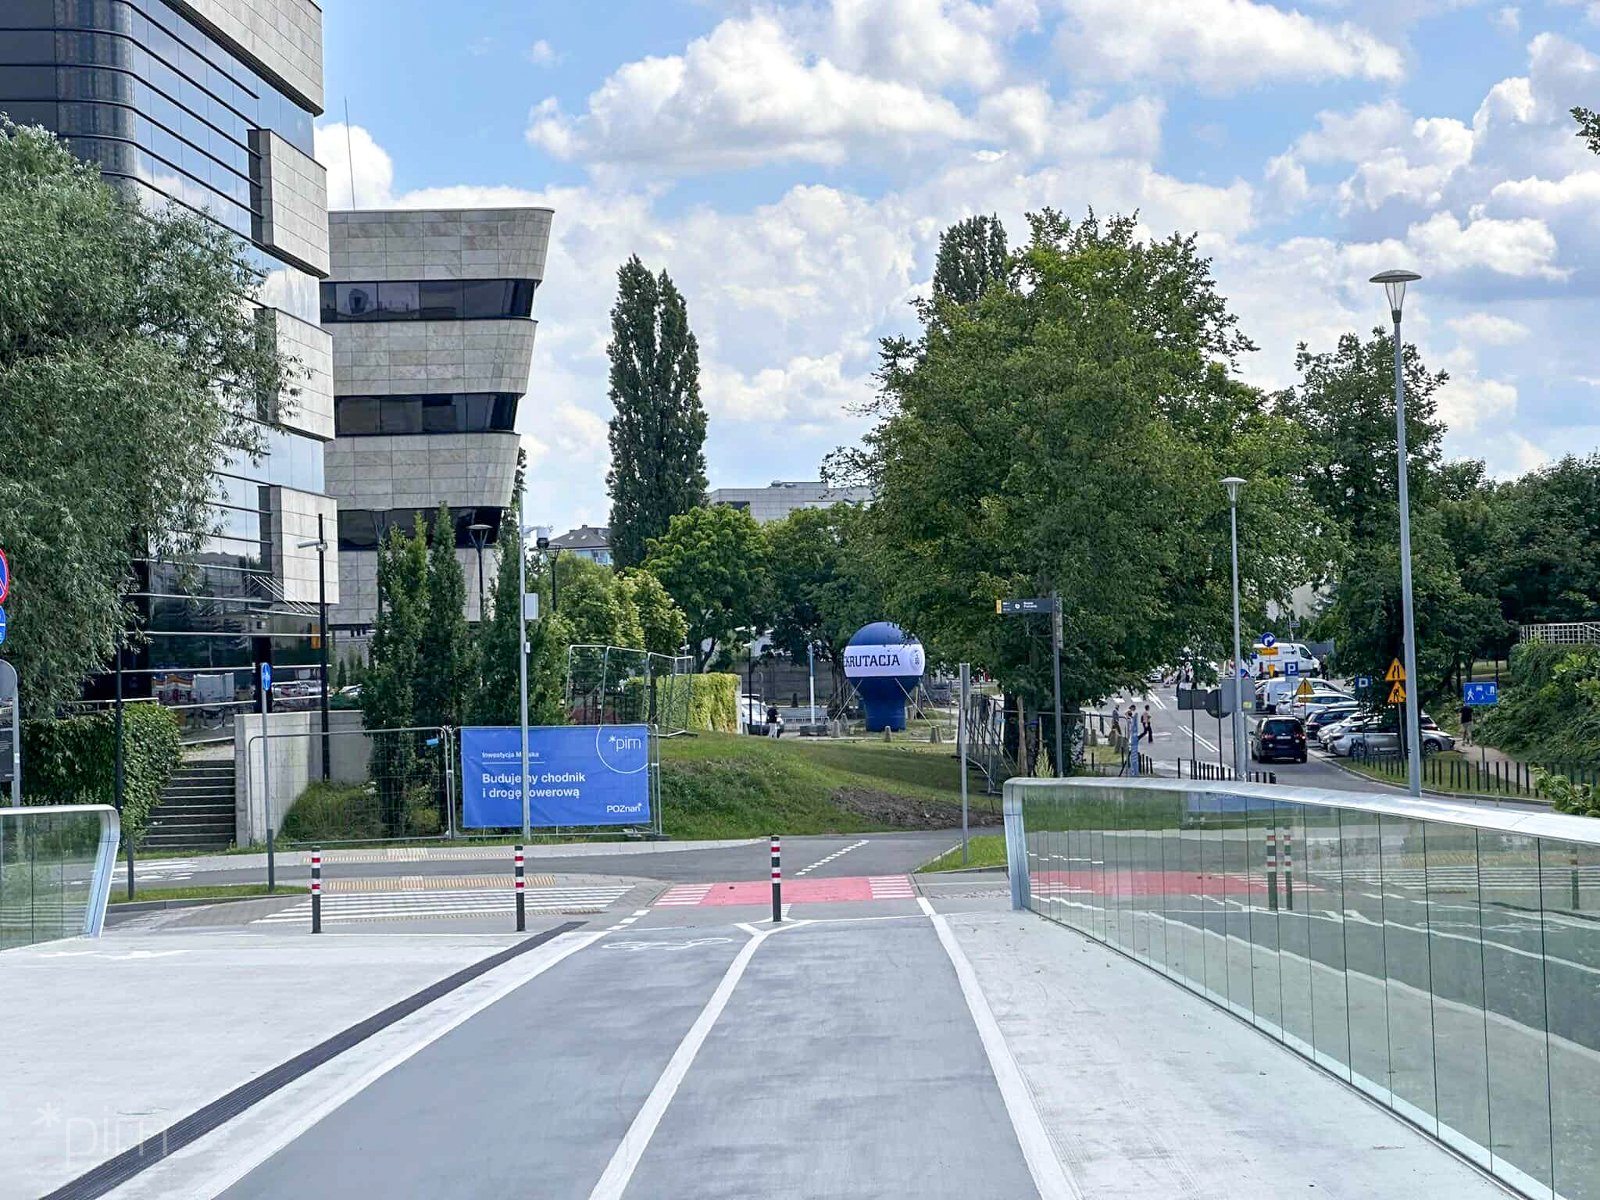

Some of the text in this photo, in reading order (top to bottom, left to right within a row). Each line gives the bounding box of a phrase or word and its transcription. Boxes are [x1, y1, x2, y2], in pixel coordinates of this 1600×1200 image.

[516, 751, 539, 759] Mska
[541, 772, 586, 783] chodnik
[482, 788, 580, 800] i drogę owerową
